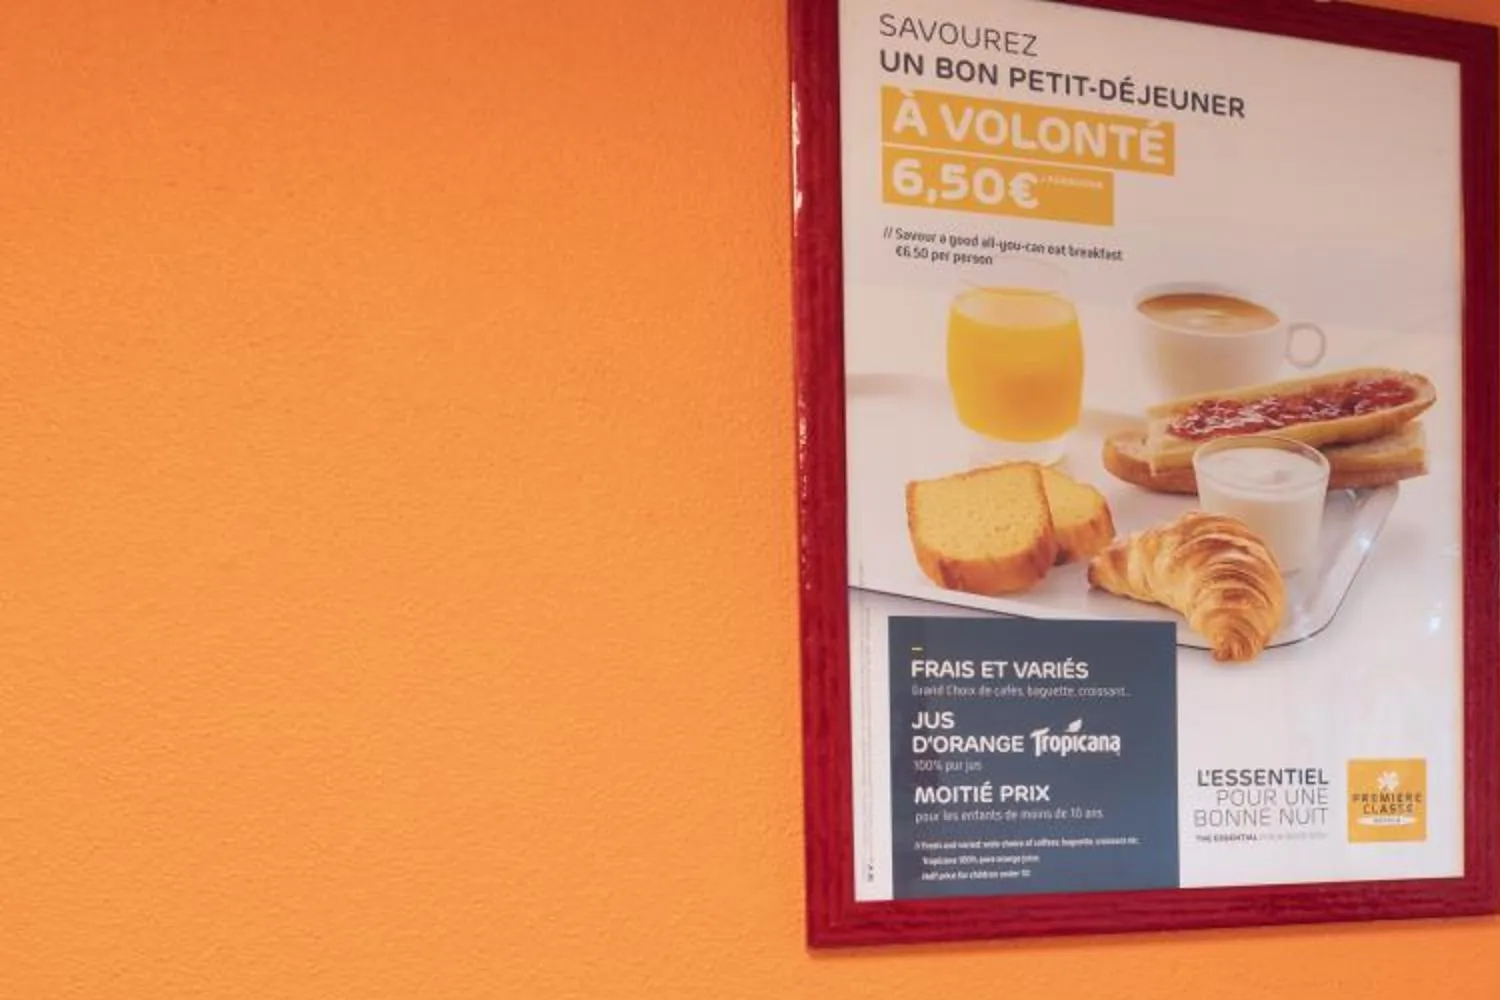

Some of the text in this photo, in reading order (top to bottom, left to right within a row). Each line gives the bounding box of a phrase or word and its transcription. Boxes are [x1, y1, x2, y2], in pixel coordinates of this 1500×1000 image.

[880, 13, 1038, 57] SAVOUREZ
[880, 50, 1246, 119] UN BON PETIT-DÉJEUNER
[894, 89, 1166, 166] À VOLONTÉ
[893, 158, 1040, 210] 6,50€
[896, 228, 937, 244] Savour
[950, 236, 979, 249] good
[982, 237, 1045, 254] all-you-can
[1069, 247, 1122, 261] breakfast
[932, 249, 949, 262] per
[953, 252, 994, 265] person
[911, 657, 1090, 680] FRAIS ET VARIÉS
[911, 711, 956, 730] JUS
[912, 727, 1122, 757] D'ORANGE Tropicana
[1196, 768, 1330, 788] L'ESSENTIEL
[915, 781, 1051, 805] MOITIÉ PRIX
[1216, 787, 1329, 808] POUR UNE
[1193, 806, 1329, 828] BONNE NUIT
